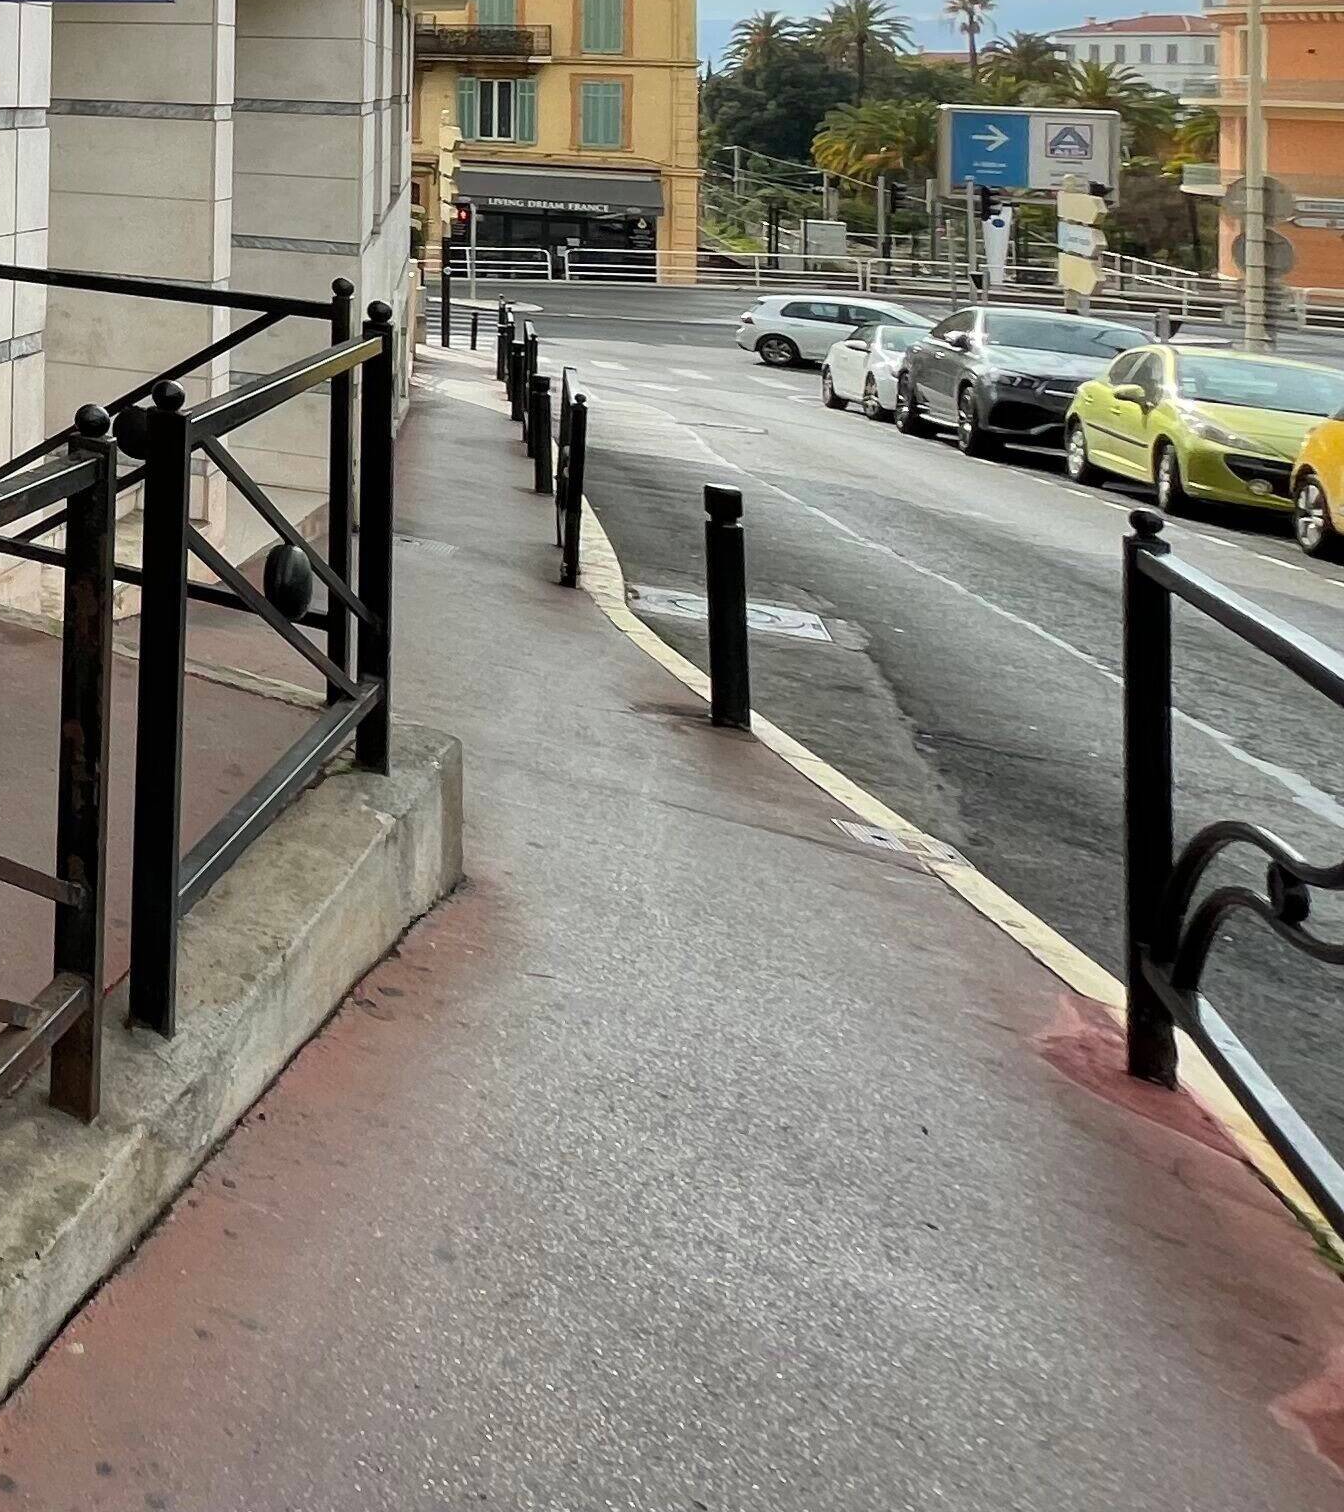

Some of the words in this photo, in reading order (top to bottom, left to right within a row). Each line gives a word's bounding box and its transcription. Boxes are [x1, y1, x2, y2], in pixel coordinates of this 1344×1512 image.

[488, 197, 524, 207] LIVING
[527, 200, 564, 209] DREAM
[568, 202, 610, 212] FRANCE
